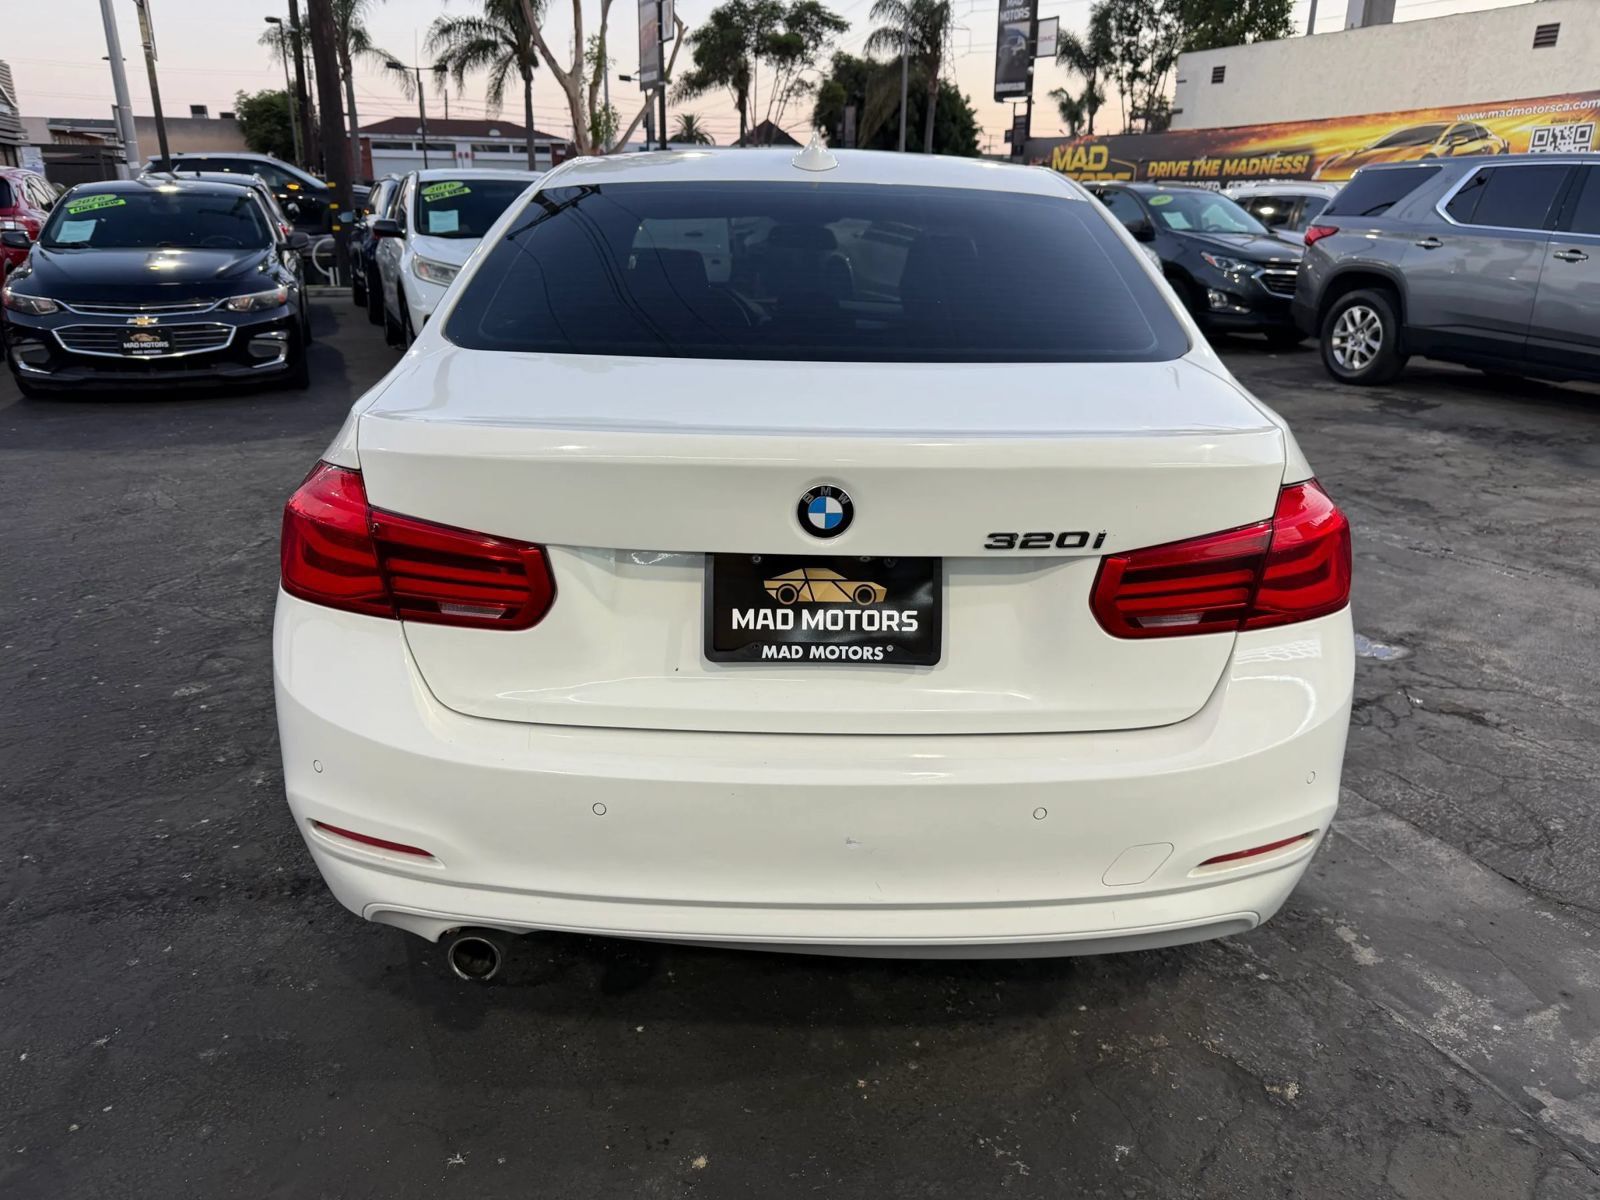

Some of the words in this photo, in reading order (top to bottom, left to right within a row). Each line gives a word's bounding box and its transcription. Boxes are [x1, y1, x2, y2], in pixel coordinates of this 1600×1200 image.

[1457, 99, 1600, 121] www.madmotorsca.com
[1052, 145, 1108, 171] MAD
[1147, 160, 1191, 177] DRIVE
[1192, 158, 1222, 176] THE
[1223, 154, 1310, 176] MADNESS!
[803, 486, 850, 504] BMW
[984, 530, 1107, 549] 320i
[732, 608, 794, 630] MAD
[801, 609, 919, 632] MOTORS
[762, 645, 803, 660] MAD
[809, 645, 884, 661] MOTORS
